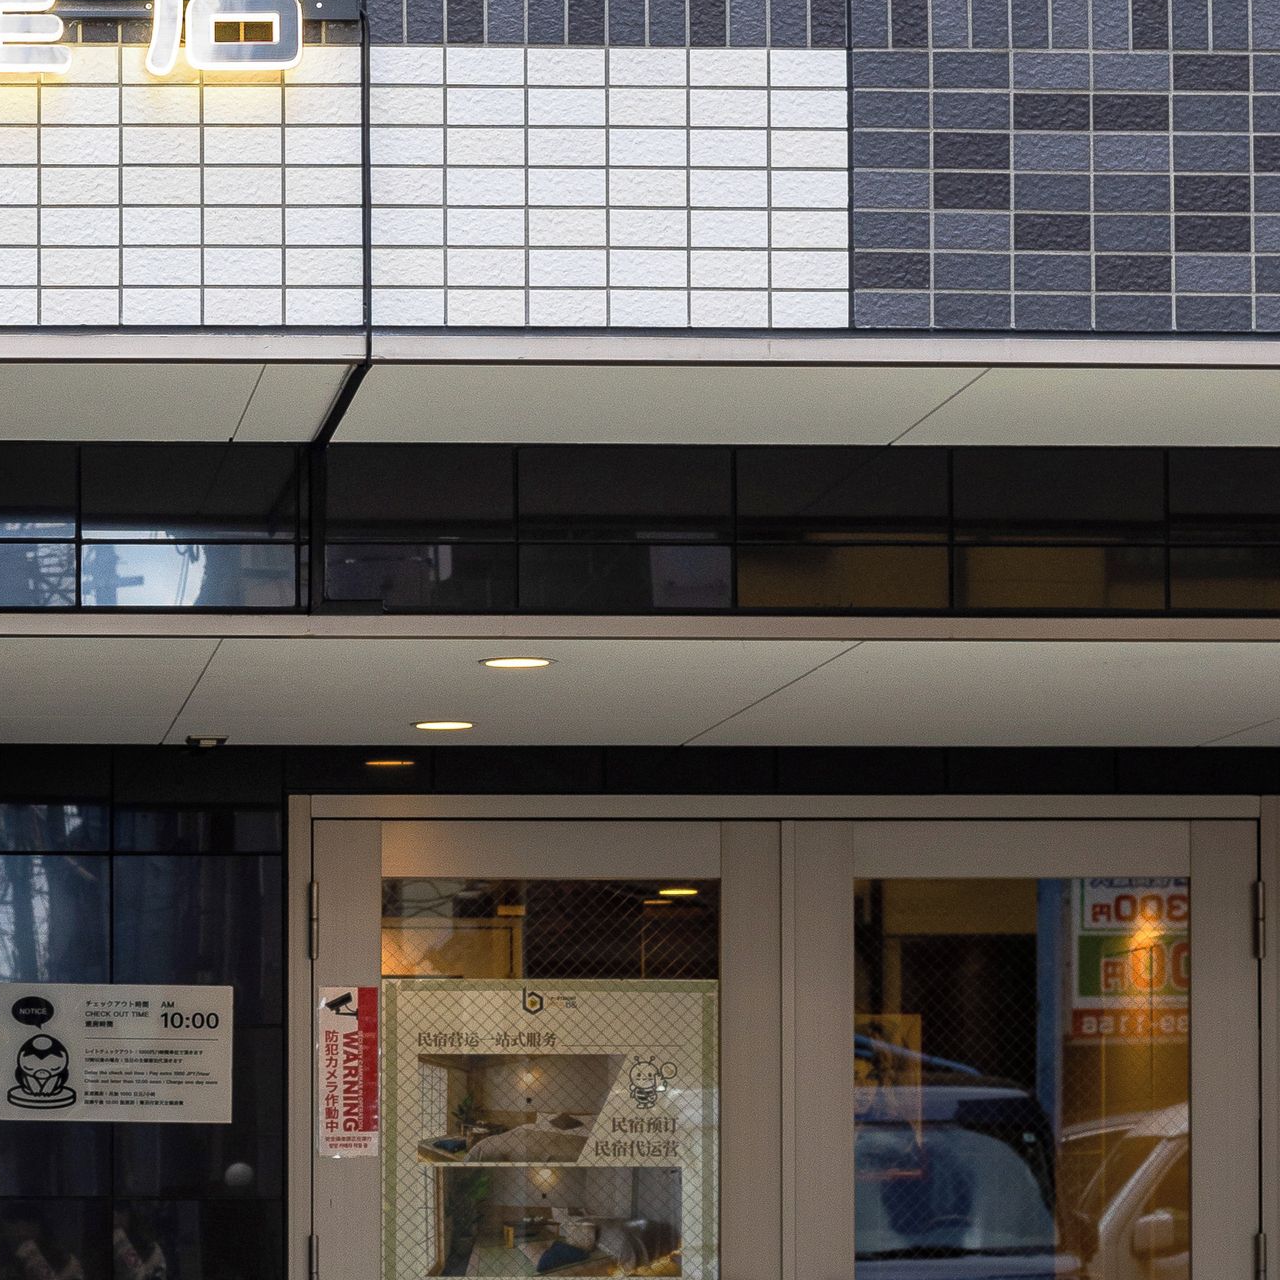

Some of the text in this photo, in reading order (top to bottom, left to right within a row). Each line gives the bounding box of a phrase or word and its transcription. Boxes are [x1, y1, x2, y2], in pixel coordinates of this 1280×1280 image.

[160, 1012, 219, 1029] 10:00
[325, 1030, 339, 1132] 防犯カメラ作動中
[343, 1031, 359, 1132] WARNING
